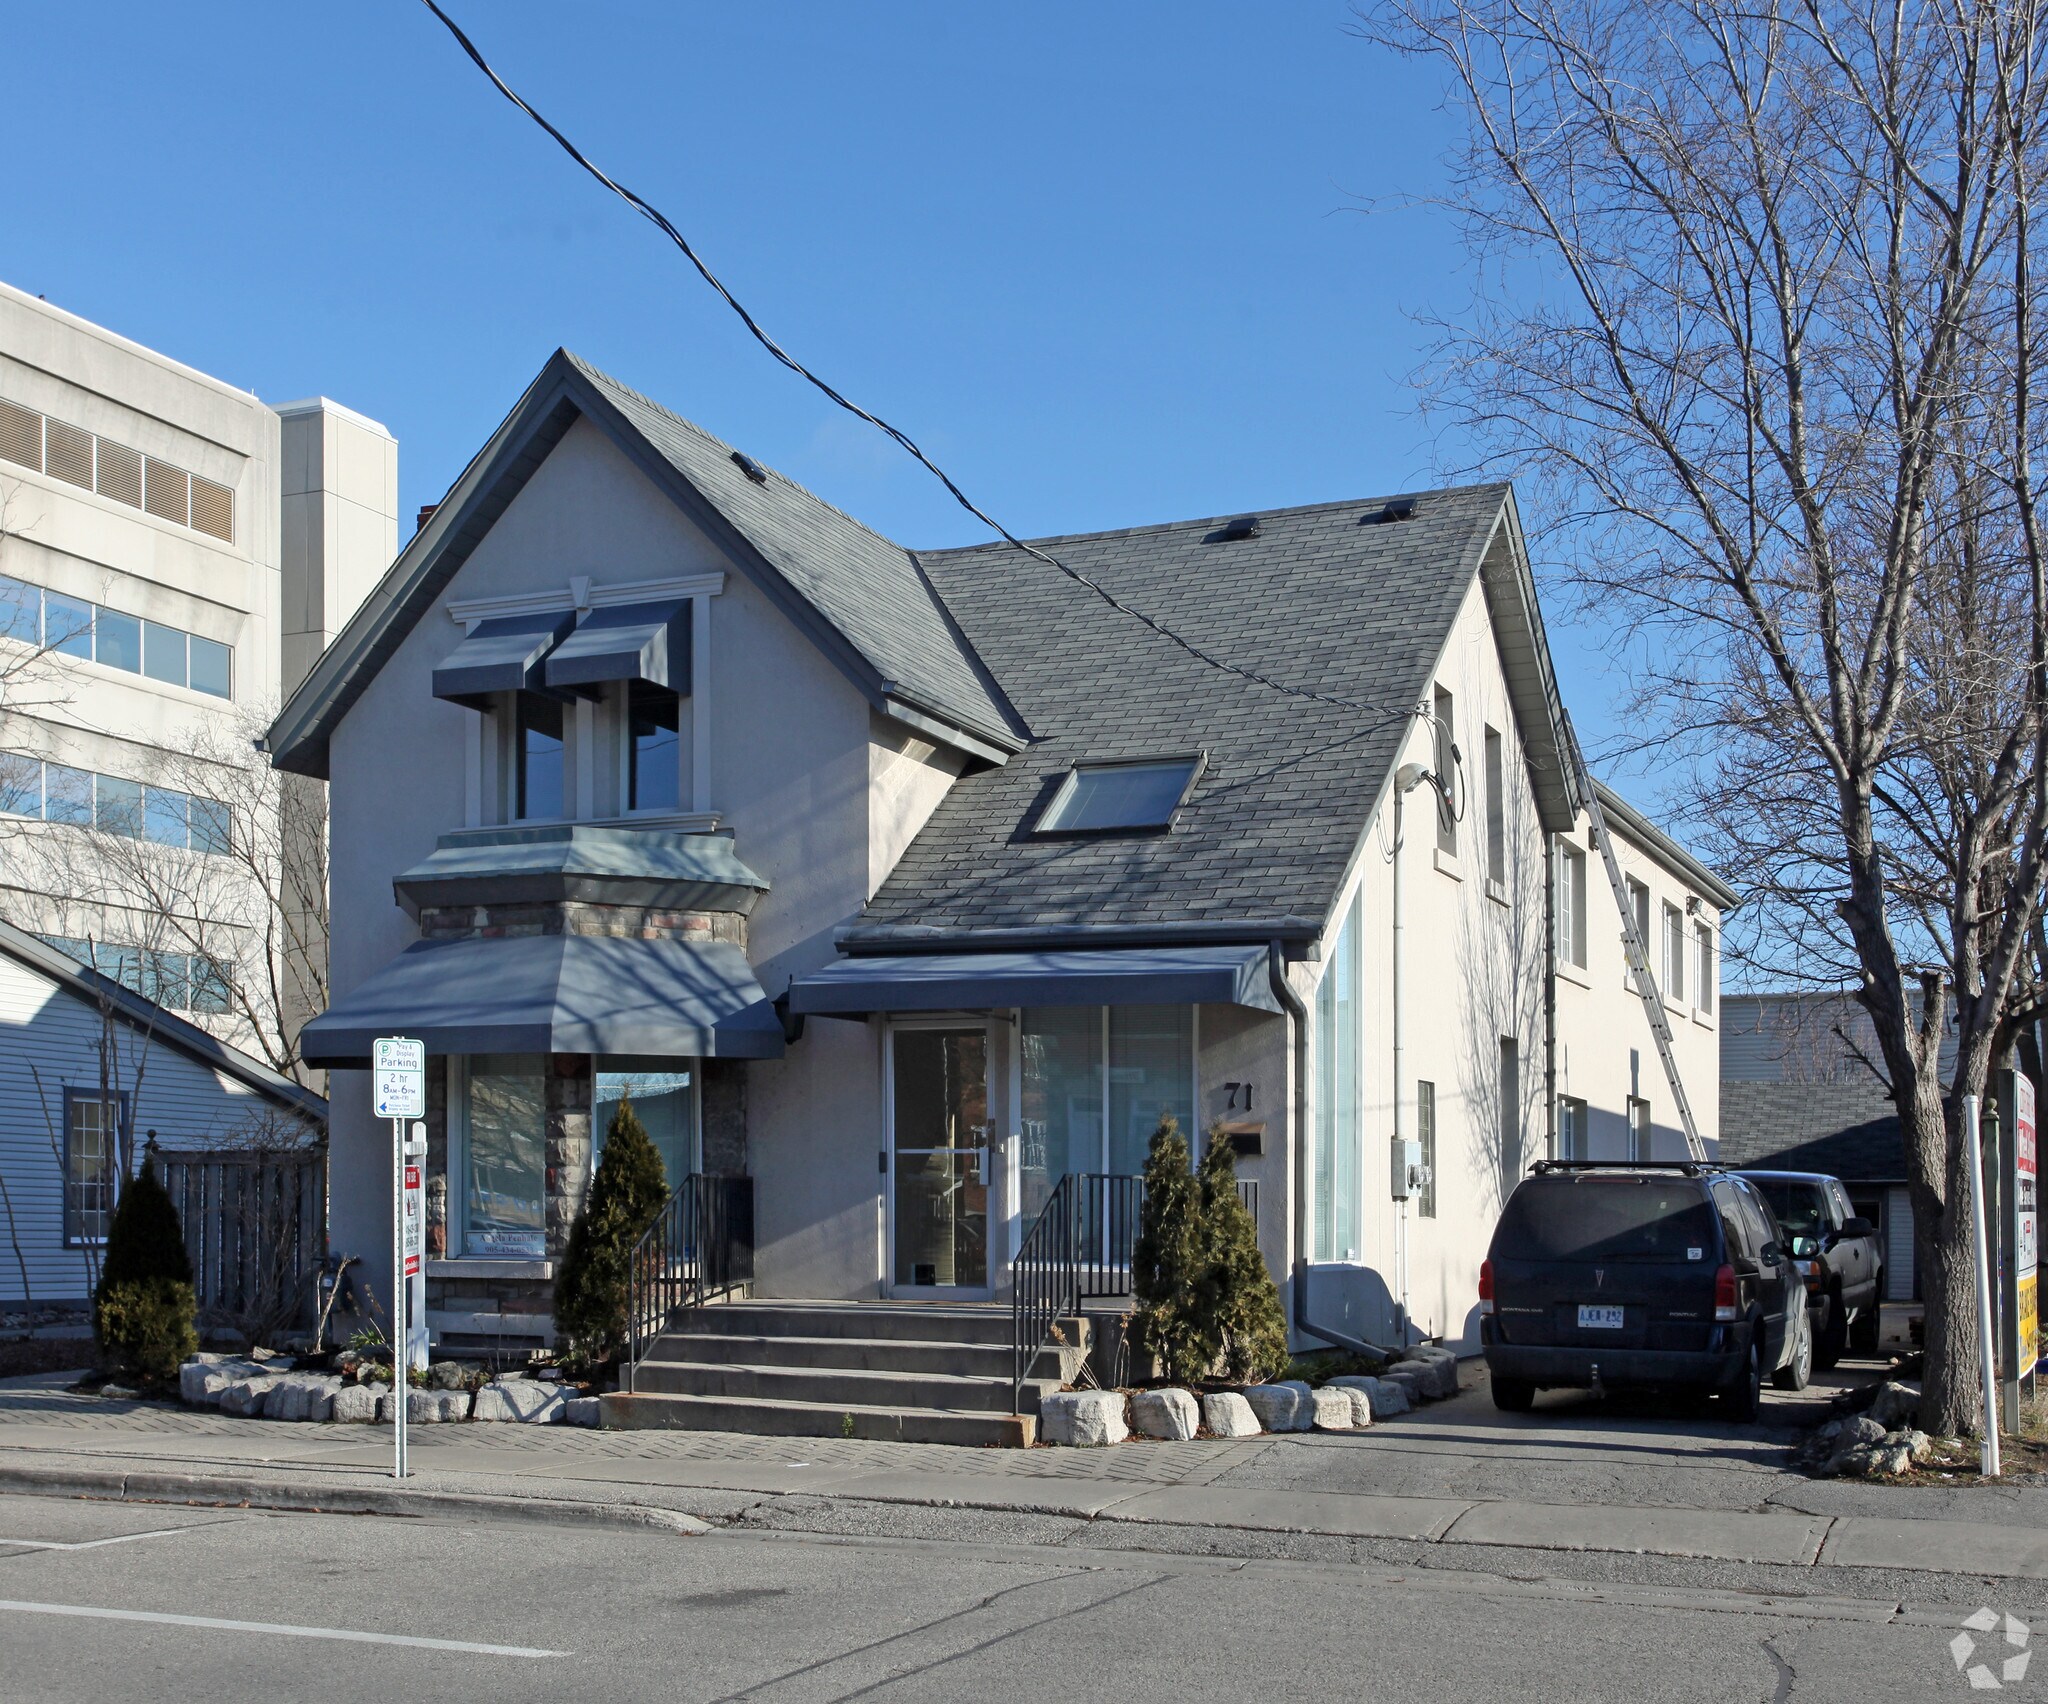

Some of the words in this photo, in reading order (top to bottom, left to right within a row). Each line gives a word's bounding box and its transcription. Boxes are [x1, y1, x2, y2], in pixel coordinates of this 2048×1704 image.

[396, 1050, 415, 1058] Display
[381, 1058, 418, 1070] Parking
[390, 1073, 396, 1083] 2
[399, 1073, 408, 1083] hr
[1224, 1082, 1254, 1112] 71
